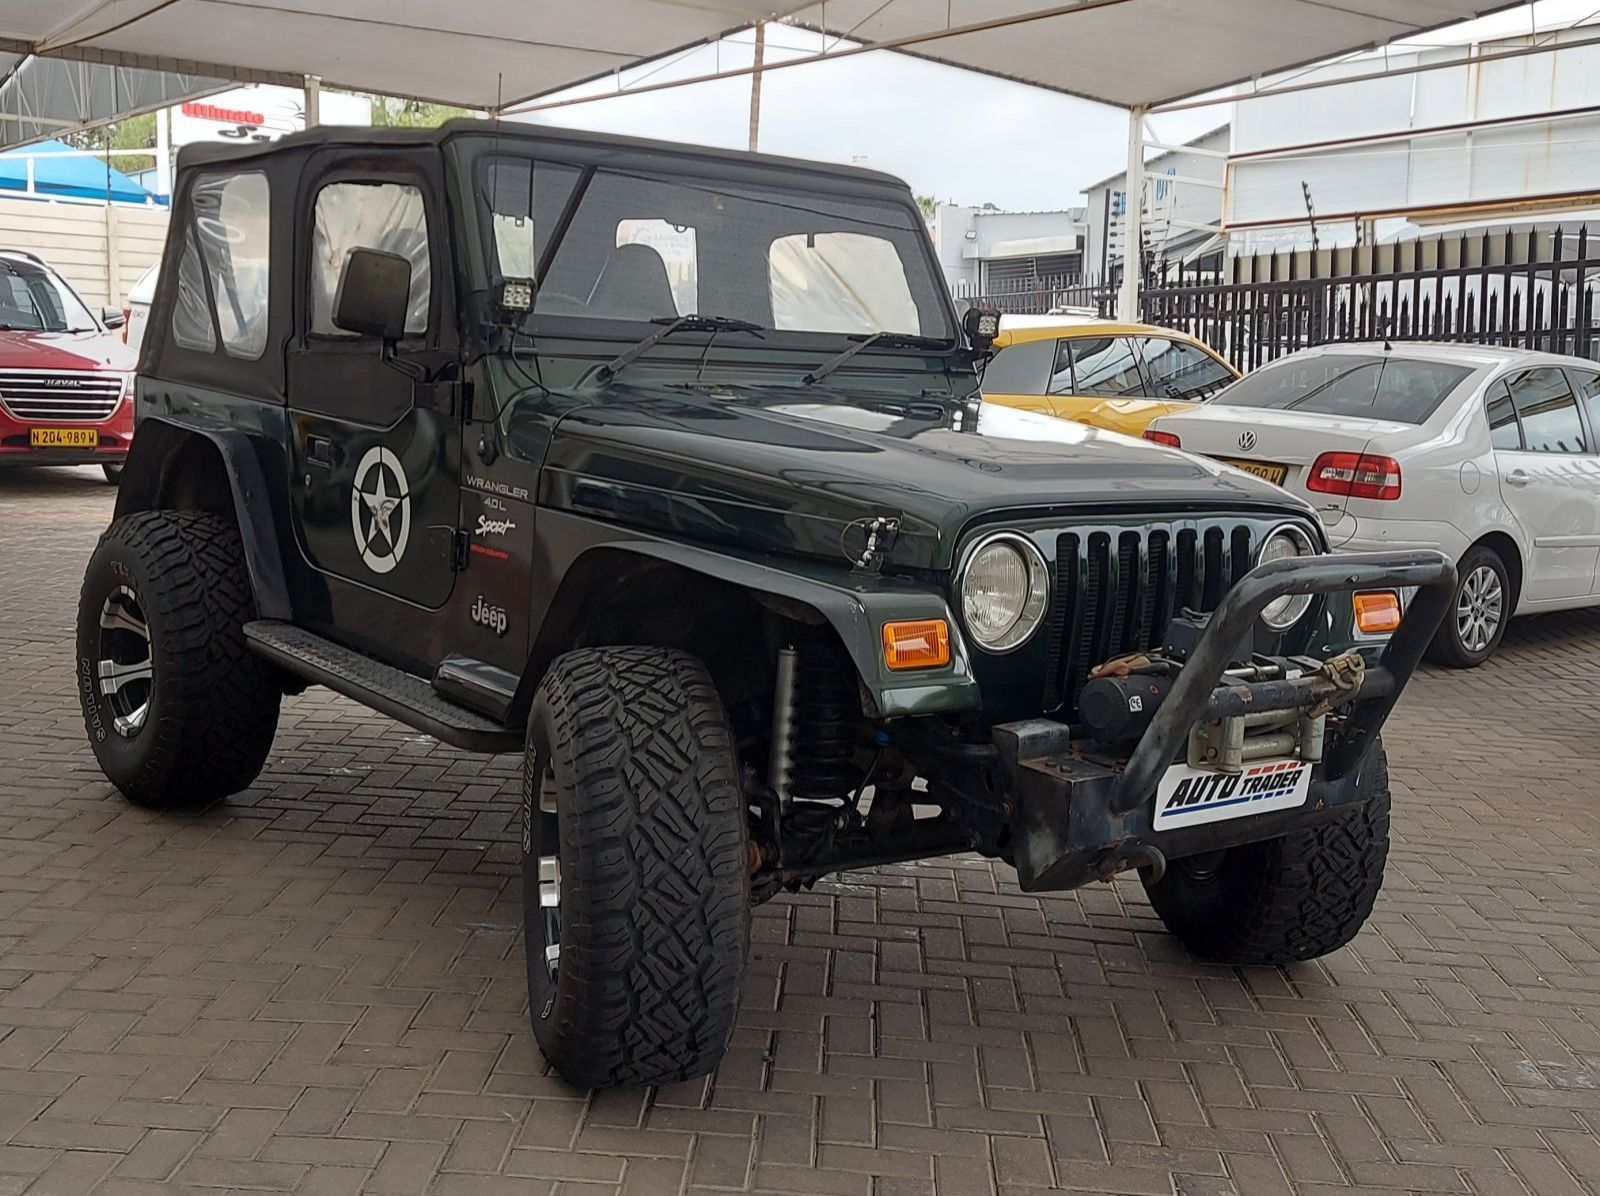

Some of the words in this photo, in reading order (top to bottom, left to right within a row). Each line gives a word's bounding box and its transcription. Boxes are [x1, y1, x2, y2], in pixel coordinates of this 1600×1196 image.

[46, 379, 81, 388] HAVAL
[32, 432, 39, 443] N
[88, 432, 95, 443] W
[466, 475, 529, 500] WRANGLER
[475, 515, 516, 538] Sport
[472, 595, 507, 634] Jeep
[81, 657, 106, 743] SAILUN
[1165, 770, 1244, 810] AUTO
[1238, 769, 1304, 797] TRADER
